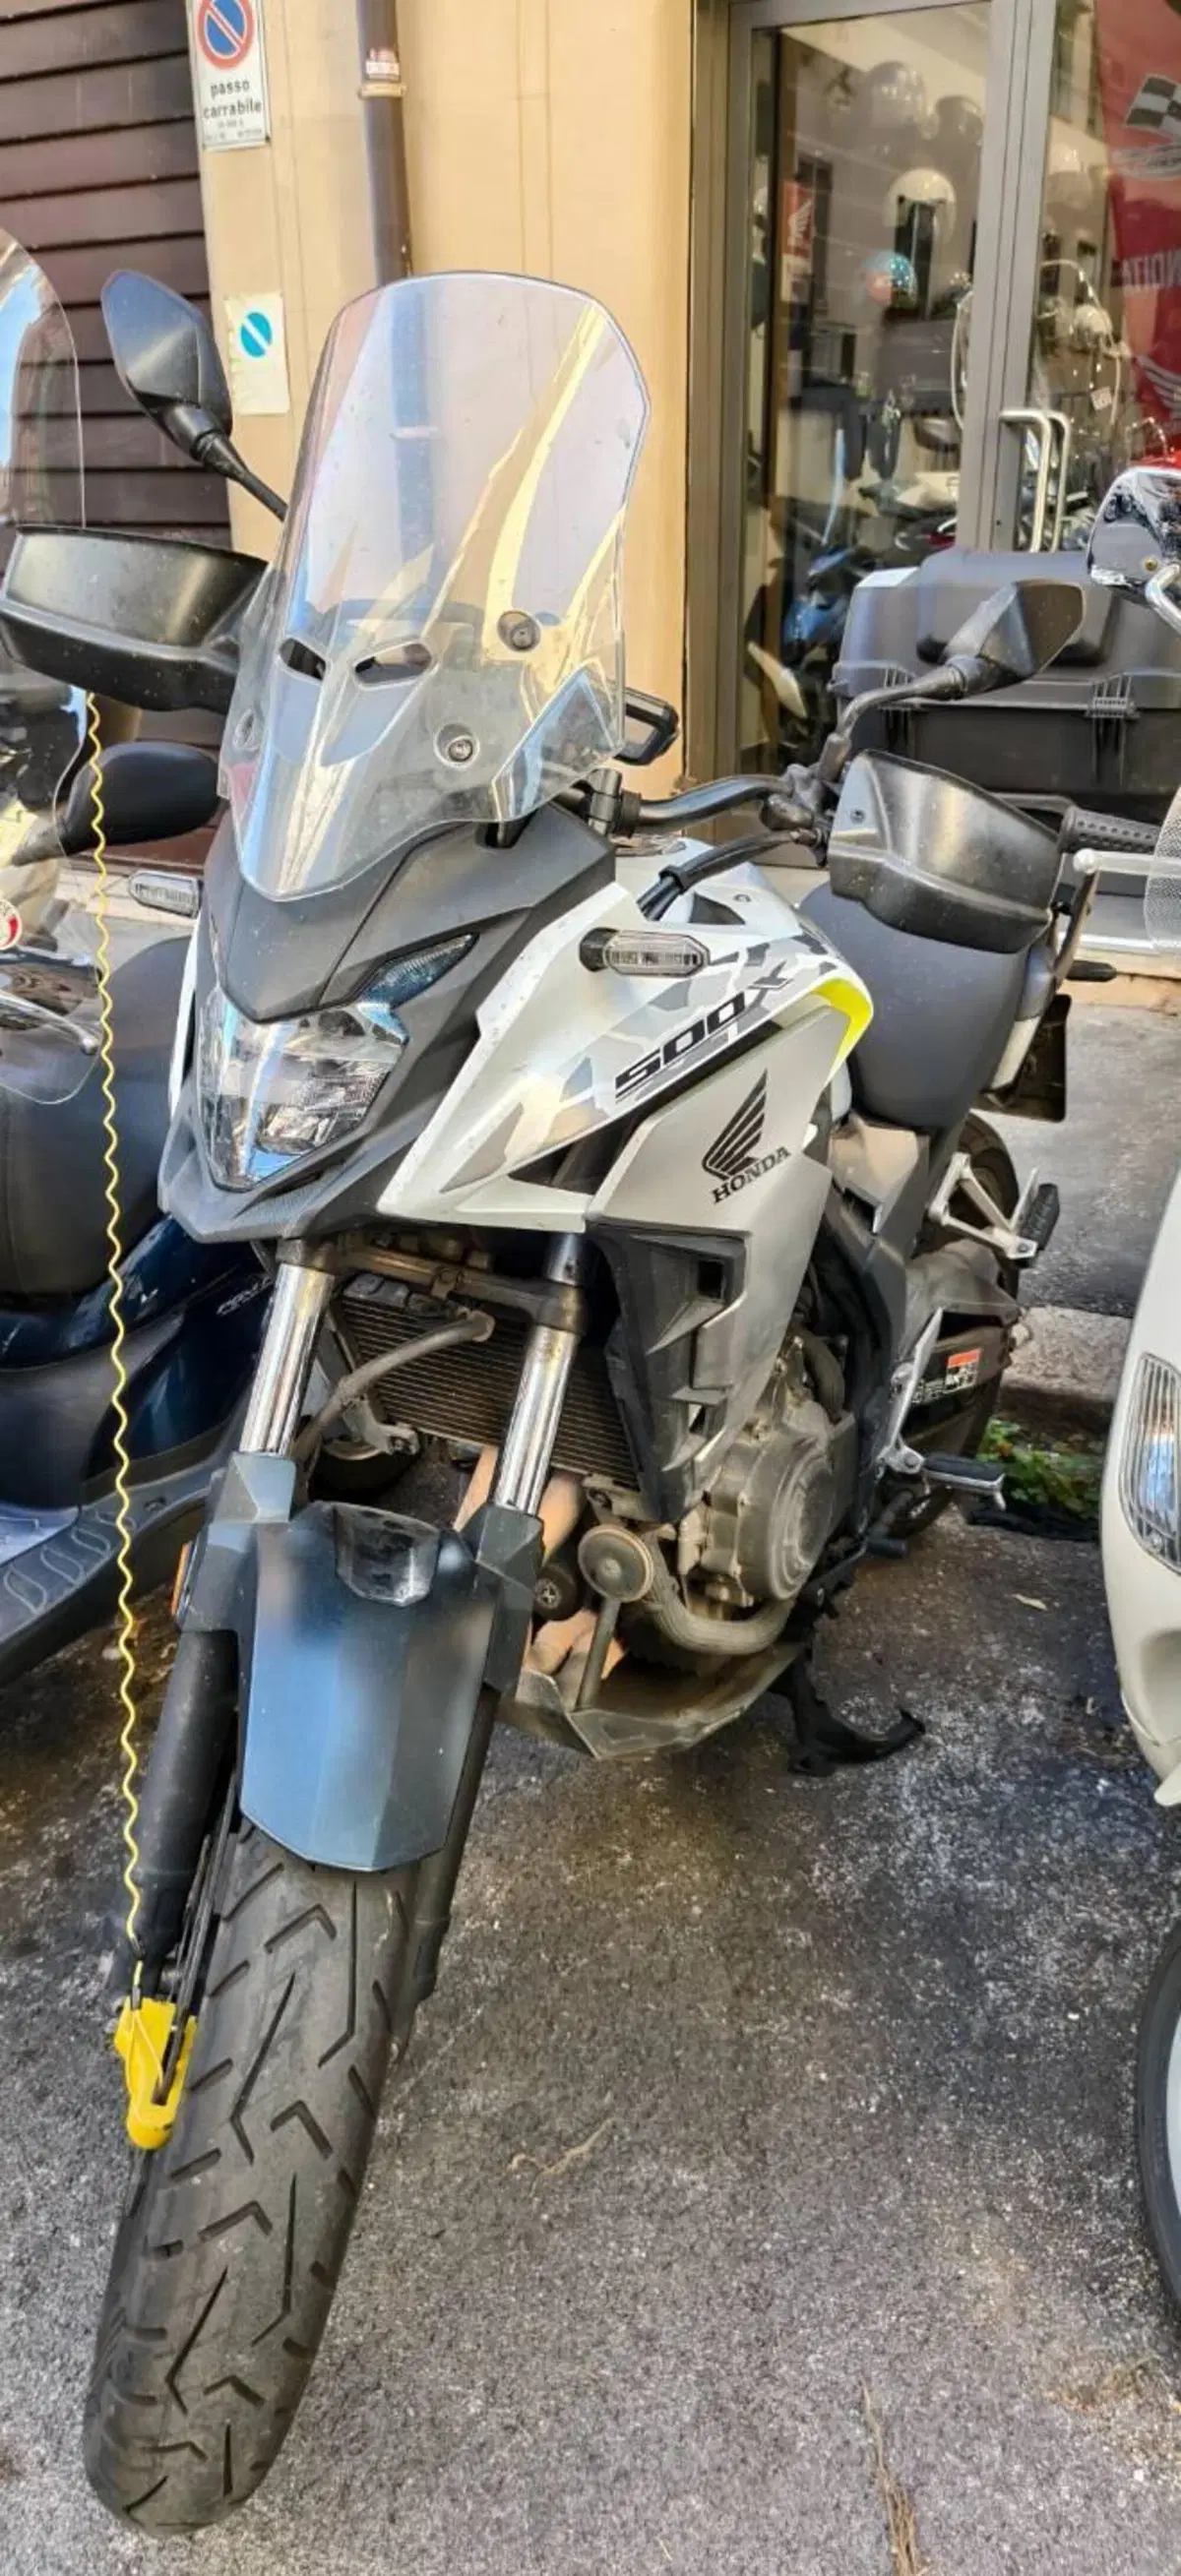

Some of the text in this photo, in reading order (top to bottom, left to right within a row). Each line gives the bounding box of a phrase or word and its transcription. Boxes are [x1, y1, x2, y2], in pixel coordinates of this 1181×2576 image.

[210, 80, 250, 100] passo
[203, 97, 263, 119] carrabile
[712, 1145, 791, 1205] HONDA
